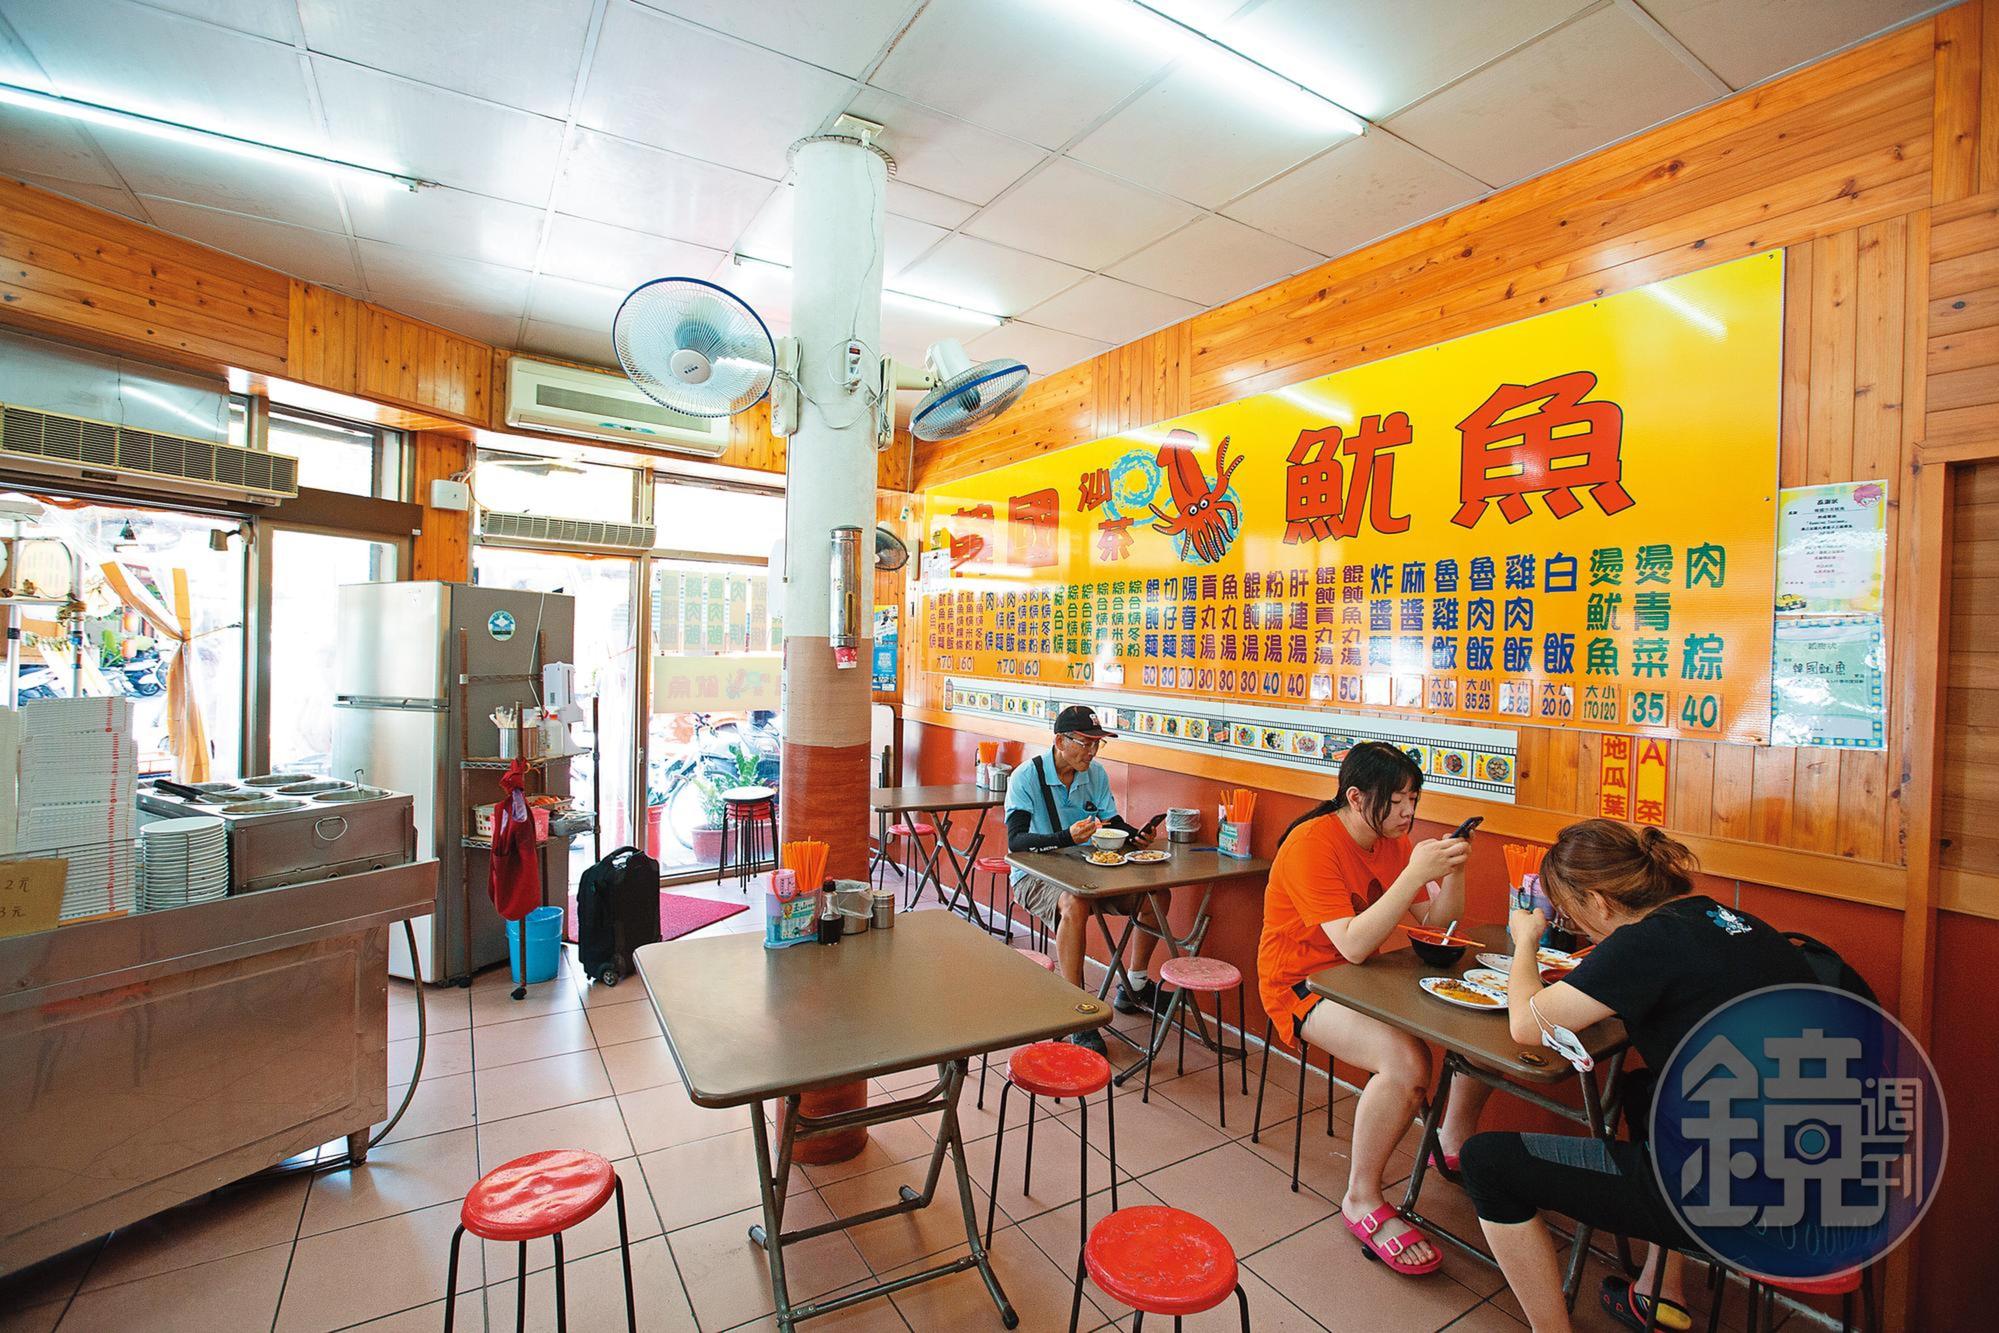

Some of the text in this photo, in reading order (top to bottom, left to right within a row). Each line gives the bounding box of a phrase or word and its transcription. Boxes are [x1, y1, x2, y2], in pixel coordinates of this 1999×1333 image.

[1282, 371, 1636, 545] 魷魚
[1162, 577, 1178, 658] 切仔麵
[1181, 576, 1198, 659] 陽春麵
[1200, 574, 1217, 660] 貢丸湯
[1220, 573, 1238, 662] 魚丸湯
[1242, 572, 1261, 662] 餛飩湯
[1264, 570, 1285, 663] 粉腸湯
[1287, 569, 1309, 664] 肝連湯
[1432, 558, 1459, 670] 魯雞飯
[1467, 556, 1496, 671] 魯肉飯
[1504, 553, 1536, 673] 雞肉飯
[1543, 551, 1578, 674] 白飯
[1586, 547, 1624, 676] 燙魷魚
[1632, 543, 1674, 678] 燙青菜
[1199, 668, 1213, 690] 30
[1219, 670, 1234, 692] 30
[1240, 671, 1256, 693] 30
[1263, 672, 1280, 695] 40
[1287, 673, 1305, 697] 40
[1339, 675, 1358, 701] 50
[1632, 691, 1665, 724] 35
[1681, 694, 1719, 728] 40
[1603, 737, 1627, 818] 地瓜葉
[1637, 739, 1664, 823] A菜
